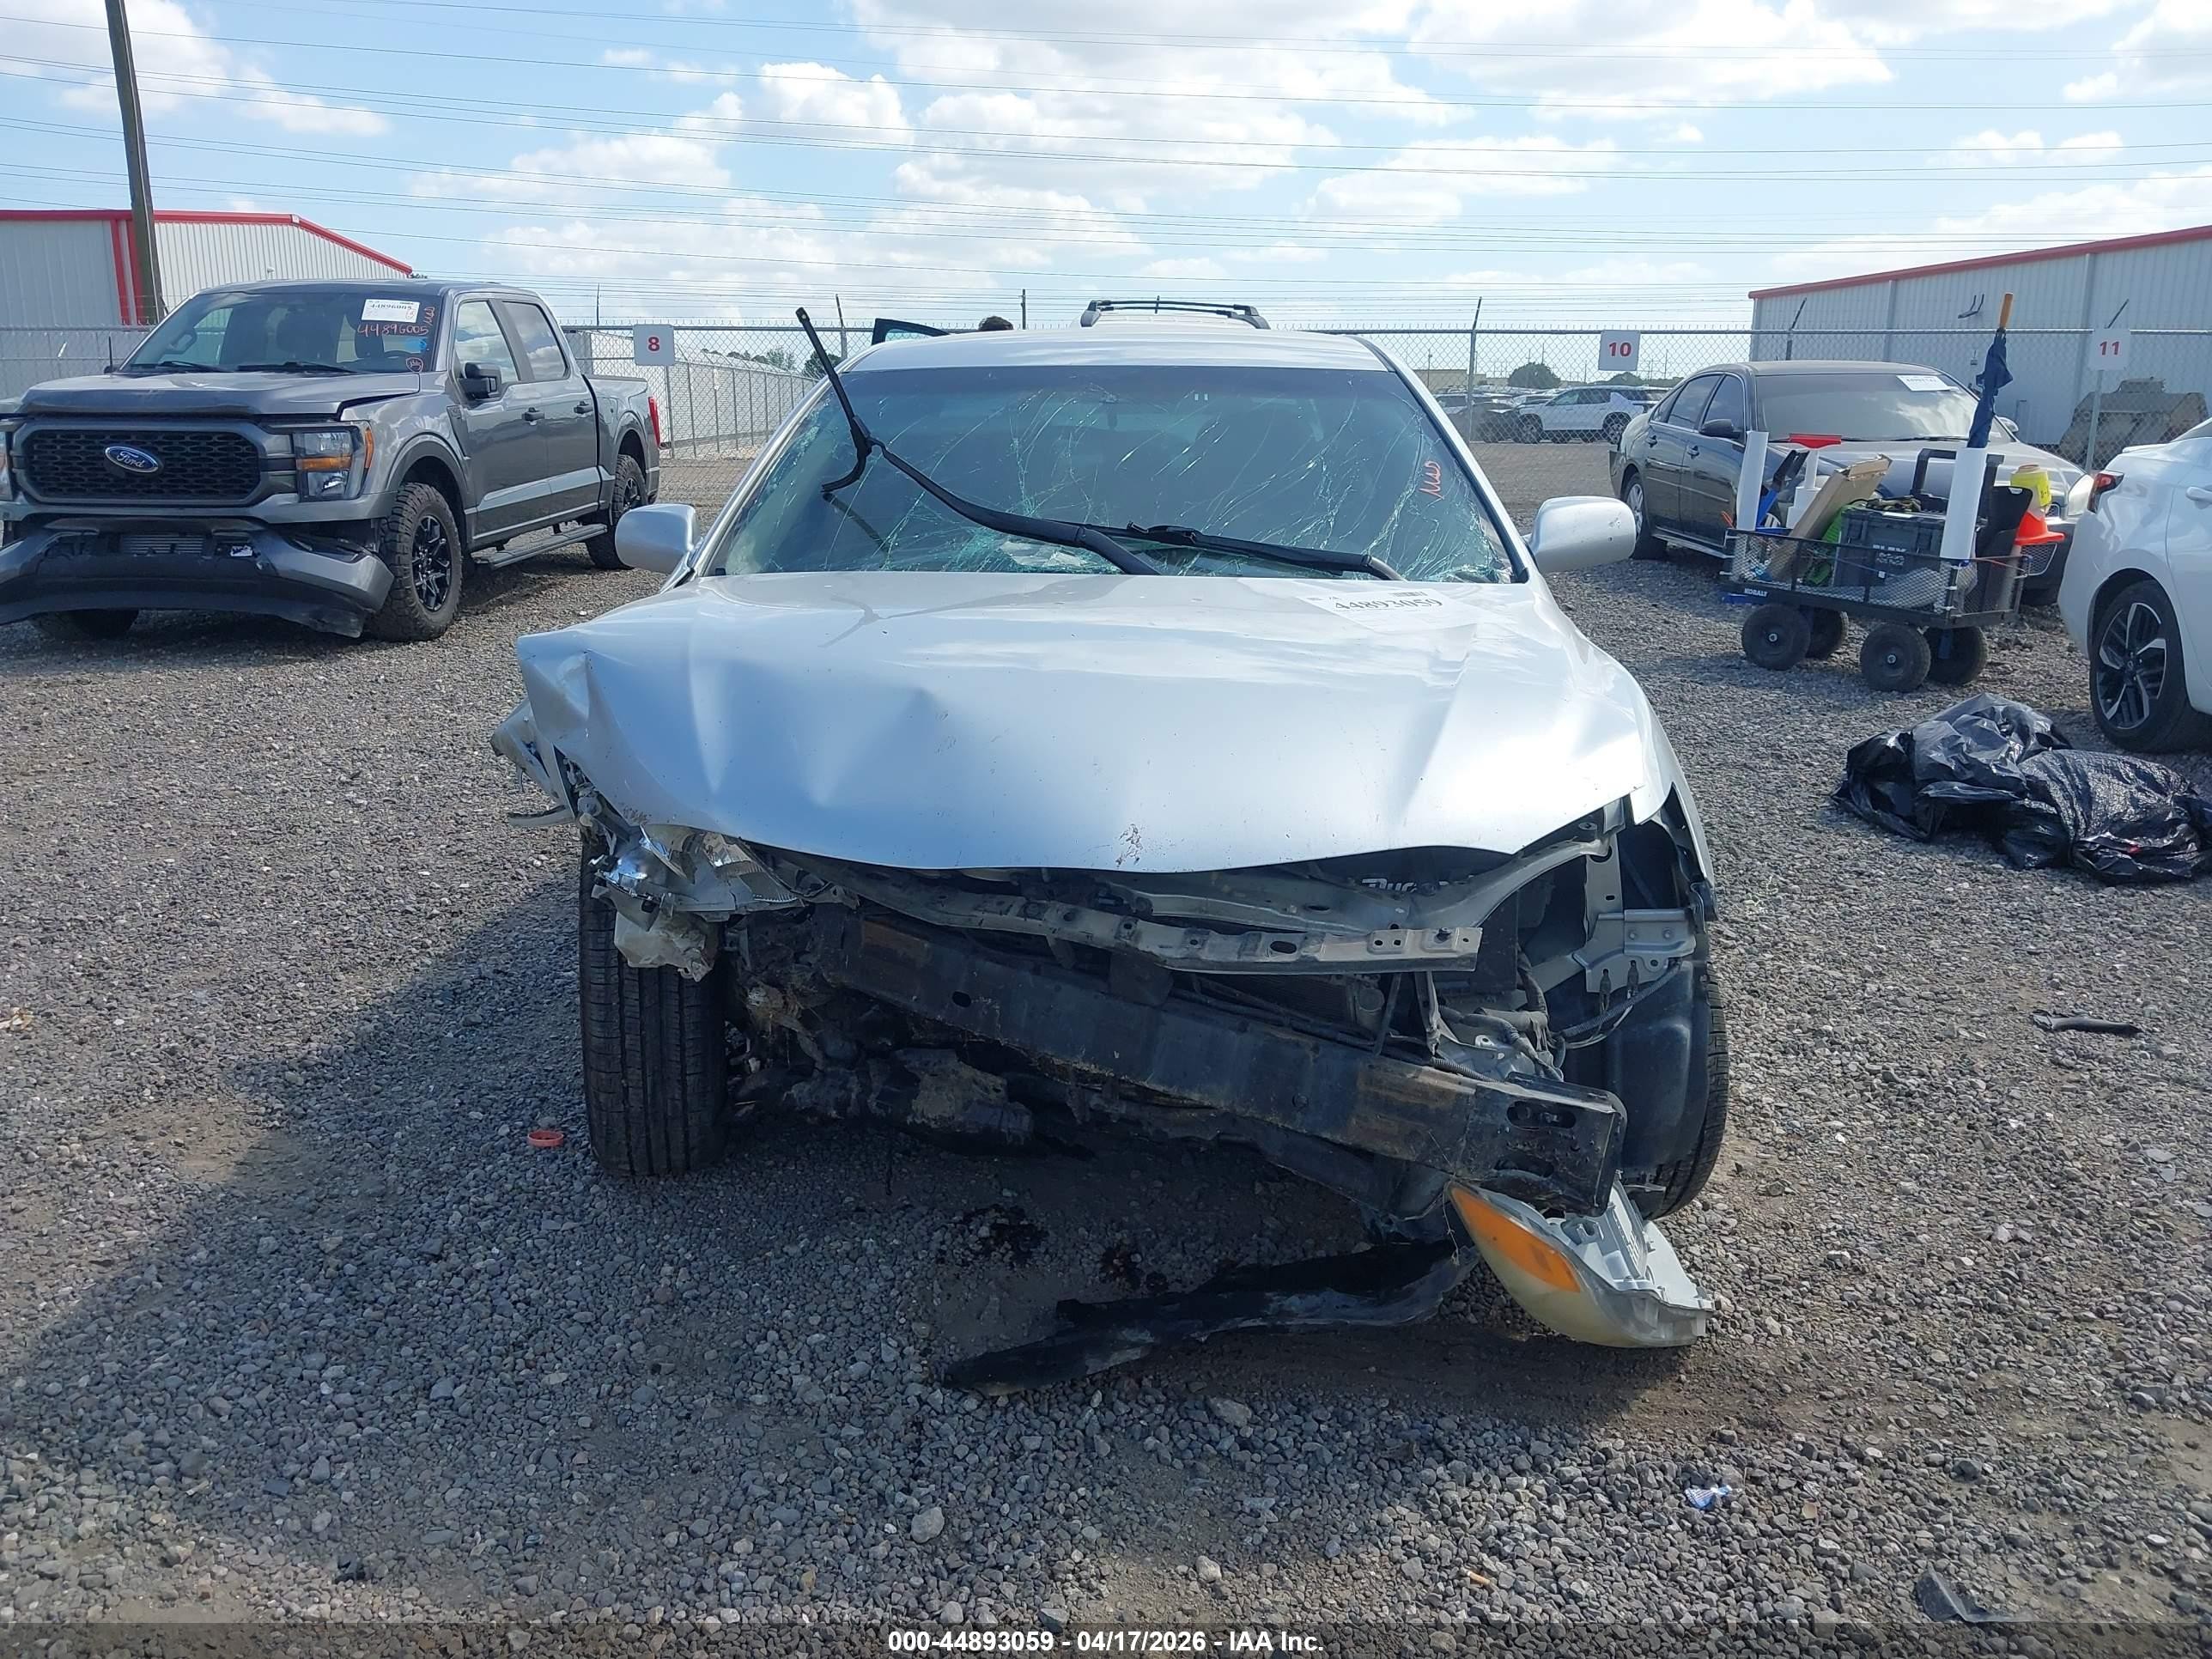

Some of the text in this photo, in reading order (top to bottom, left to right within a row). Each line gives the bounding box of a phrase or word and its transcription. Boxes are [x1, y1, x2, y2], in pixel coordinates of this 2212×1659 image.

[357, 323, 429, 337] 44896005
[647, 336, 660, 352] 8
[1608, 342, 1632, 357] 10
[2100, 341, 2120, 356] 11
[116, 451, 145, 468] Ford
[1334, 598, 1444, 611] 44893059
